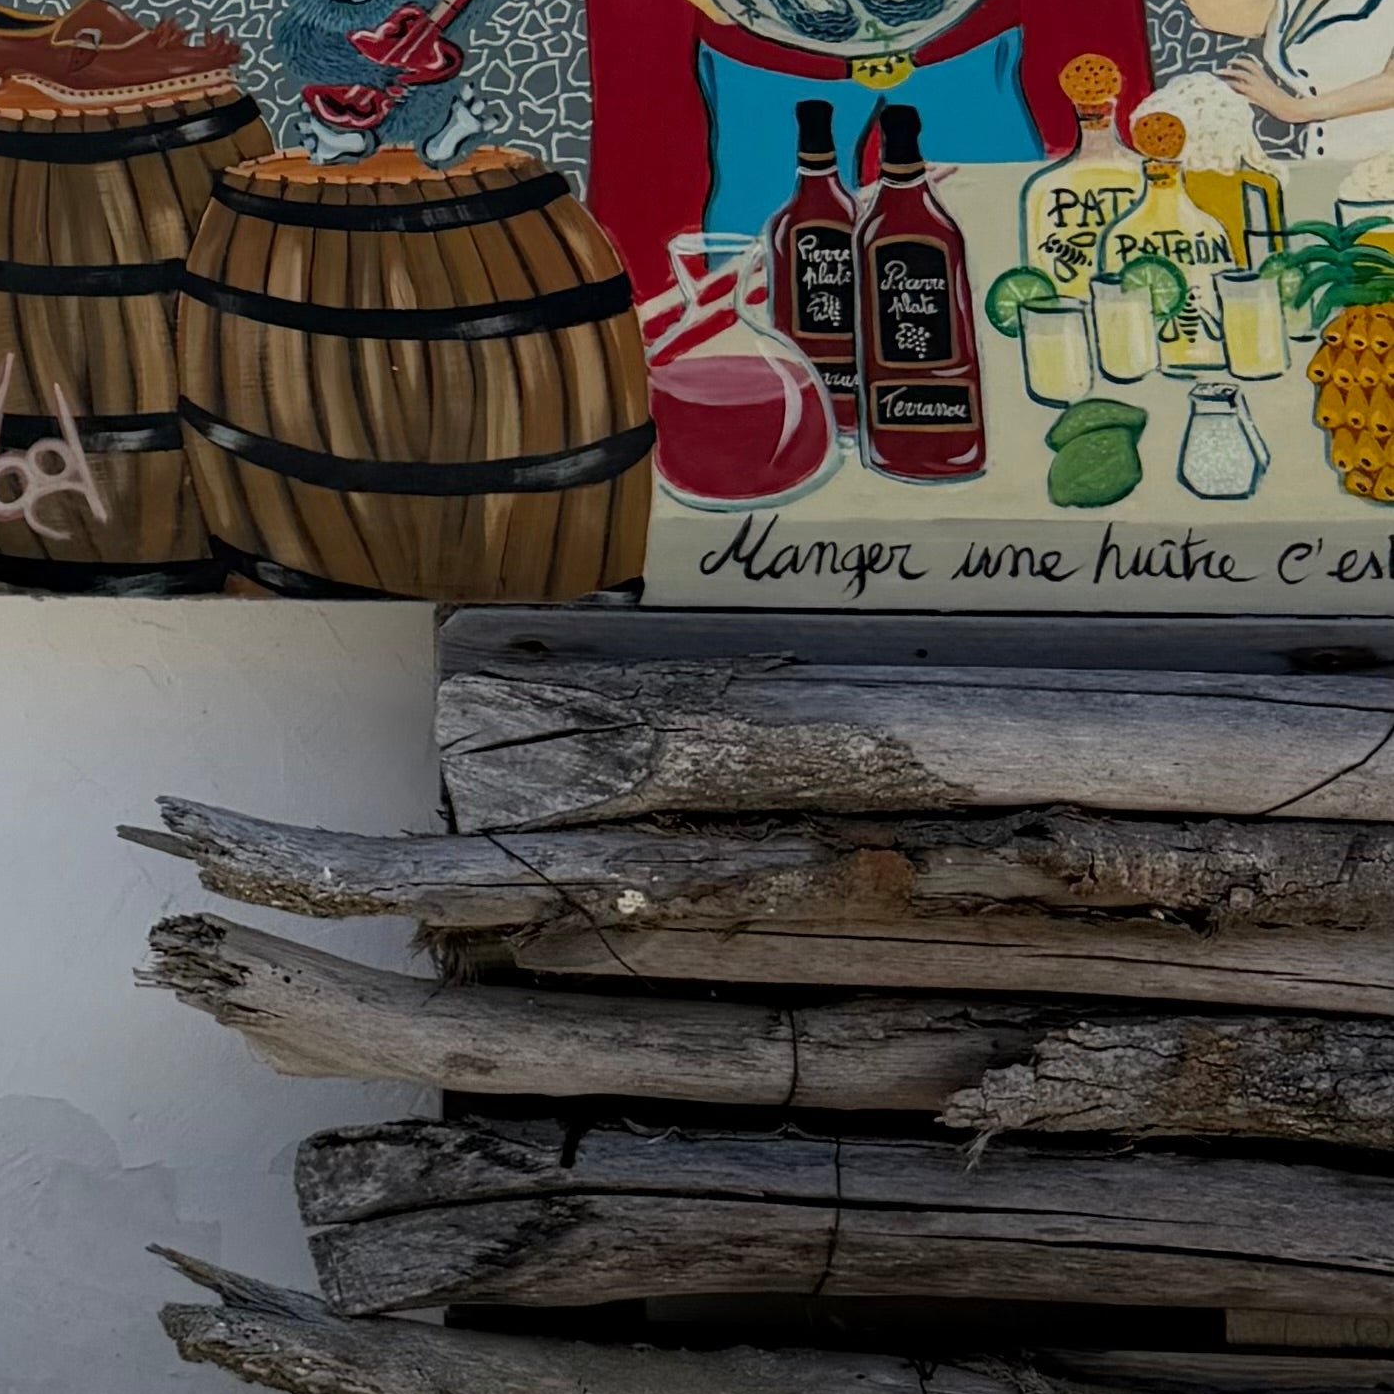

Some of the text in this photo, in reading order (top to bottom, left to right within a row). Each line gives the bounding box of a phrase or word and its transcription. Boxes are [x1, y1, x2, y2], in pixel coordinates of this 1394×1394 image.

[1047, 187, 1142, 228] PAT
[887, 291, 939, 321] plate
[700, 513, 930, 600] Manger
[951, 542, 1085, 582] une
[1093, 522, 1259, 584] huître
